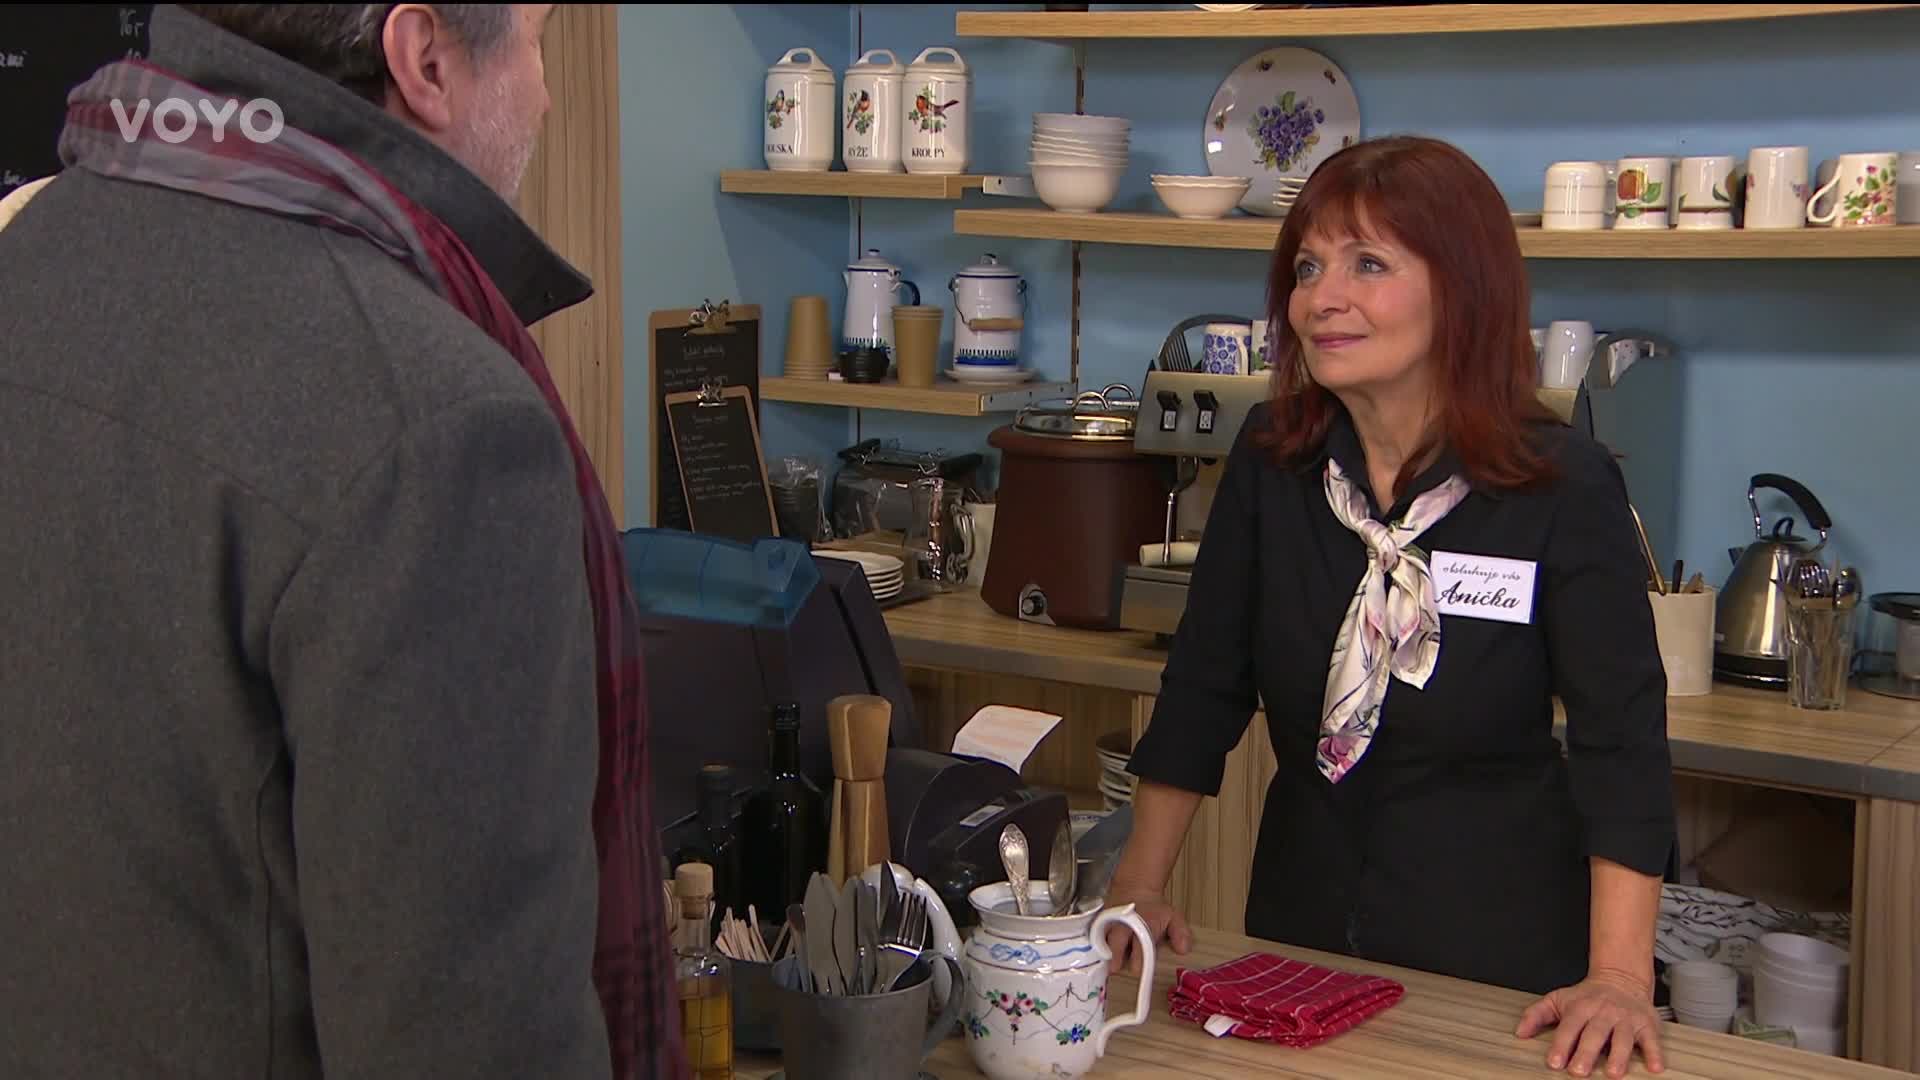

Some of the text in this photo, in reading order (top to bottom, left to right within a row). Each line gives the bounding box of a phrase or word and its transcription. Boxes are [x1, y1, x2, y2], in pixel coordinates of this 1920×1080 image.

[911, 148, 945, 158] KROUPY
[1443, 562, 1521, 584] obsluhuje vás
[1434, 580, 1520, 608] Anička
